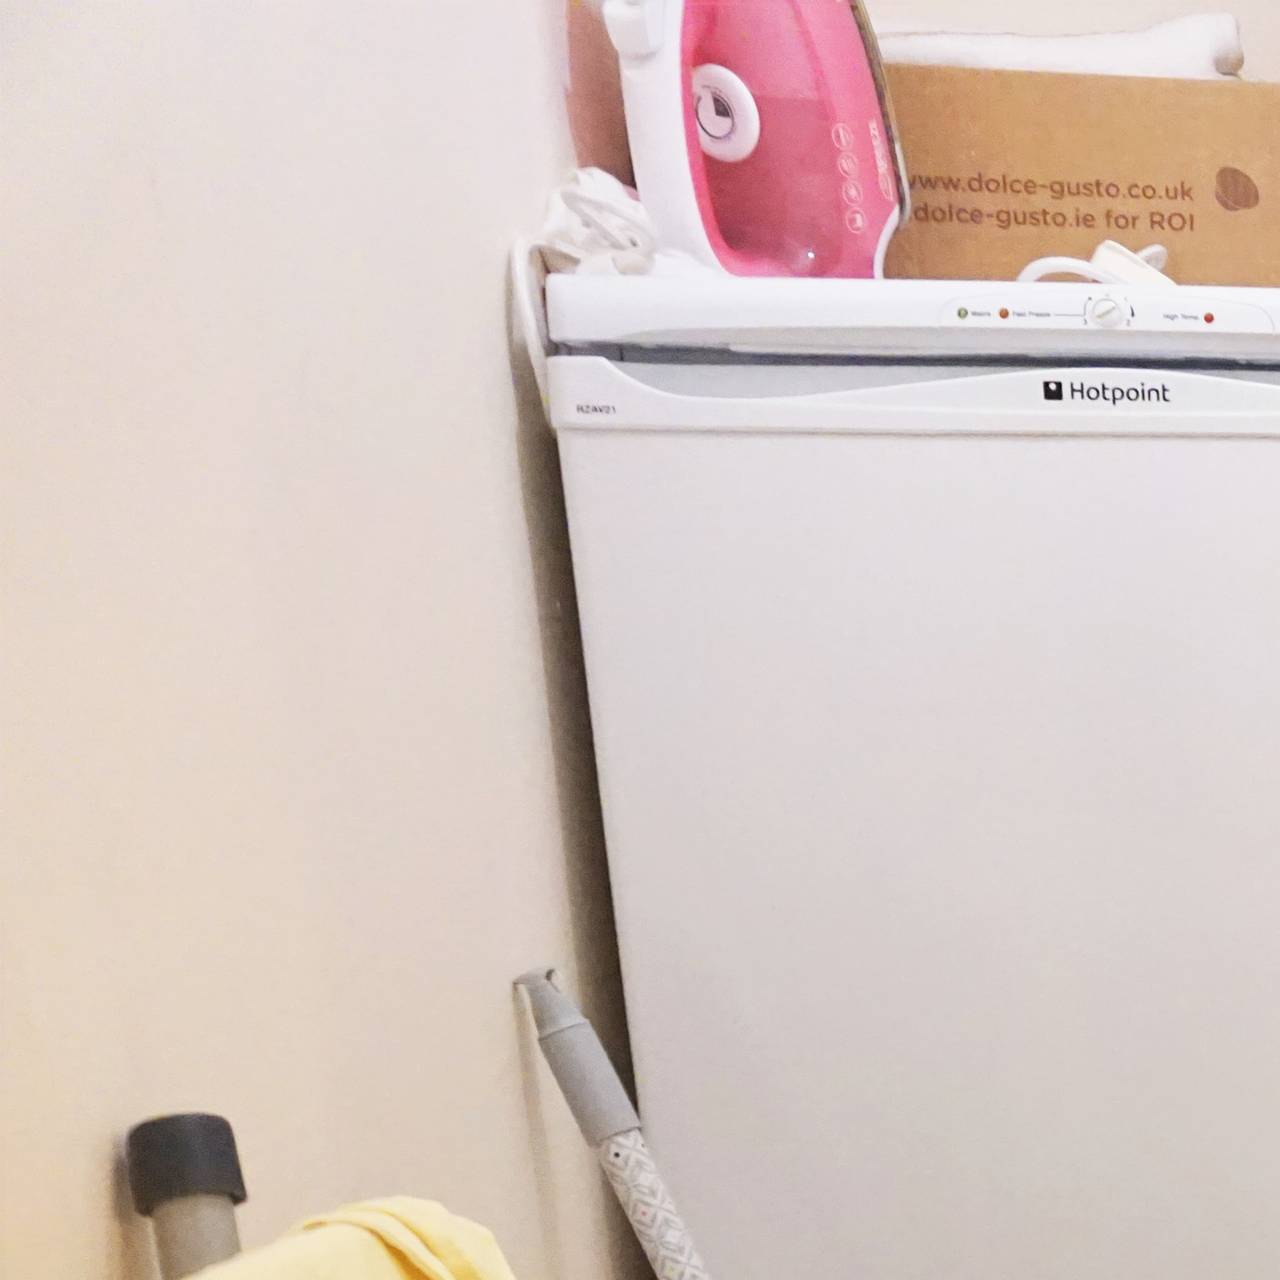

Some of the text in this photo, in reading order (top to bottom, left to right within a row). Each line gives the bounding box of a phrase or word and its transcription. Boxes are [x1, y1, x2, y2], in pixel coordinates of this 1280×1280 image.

[1105, 210, 1140, 229] for
[1150, 212, 1195, 233] ROI
[1069, 381, 1171, 405] Hotpoint
